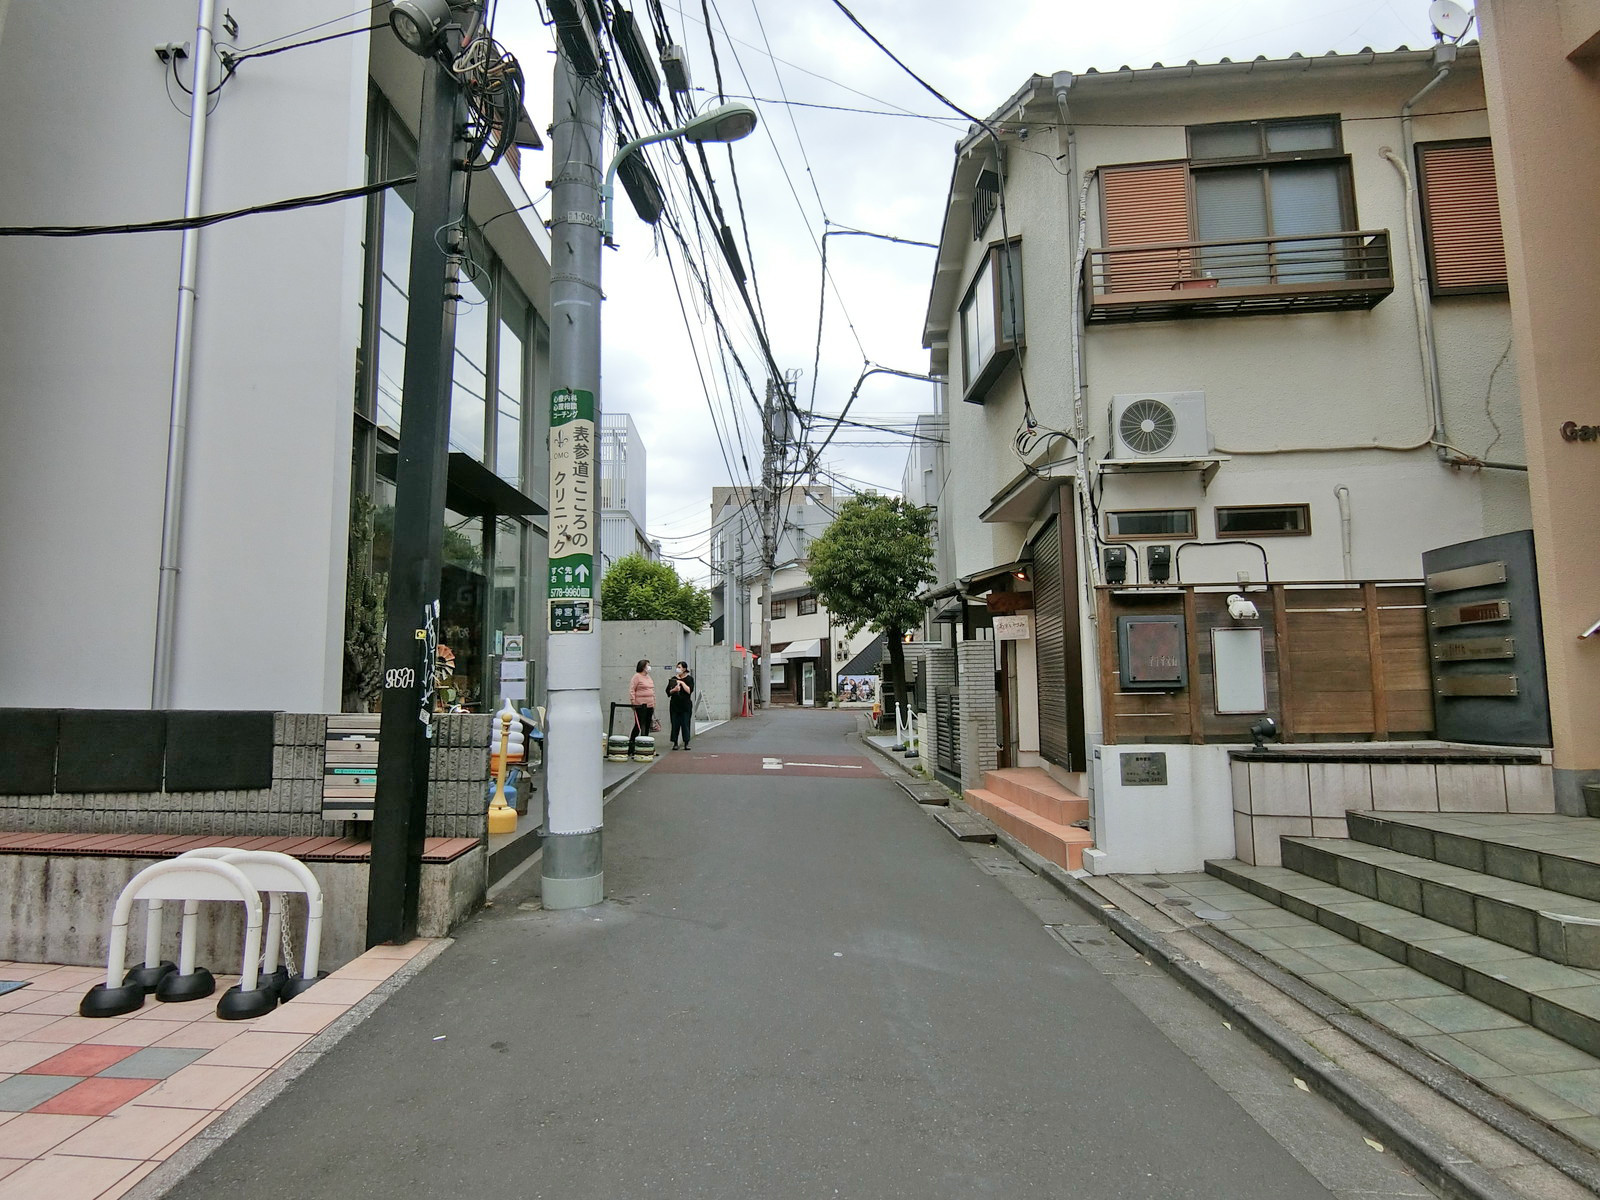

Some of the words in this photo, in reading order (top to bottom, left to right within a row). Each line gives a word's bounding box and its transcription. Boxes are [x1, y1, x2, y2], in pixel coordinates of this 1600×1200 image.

[553, 410, 579, 419] コーチング
[572, 425, 590, 548] 表参道こころの
[553, 471, 568, 555] クリニック
[551, 566, 573, 575] すぐ先
